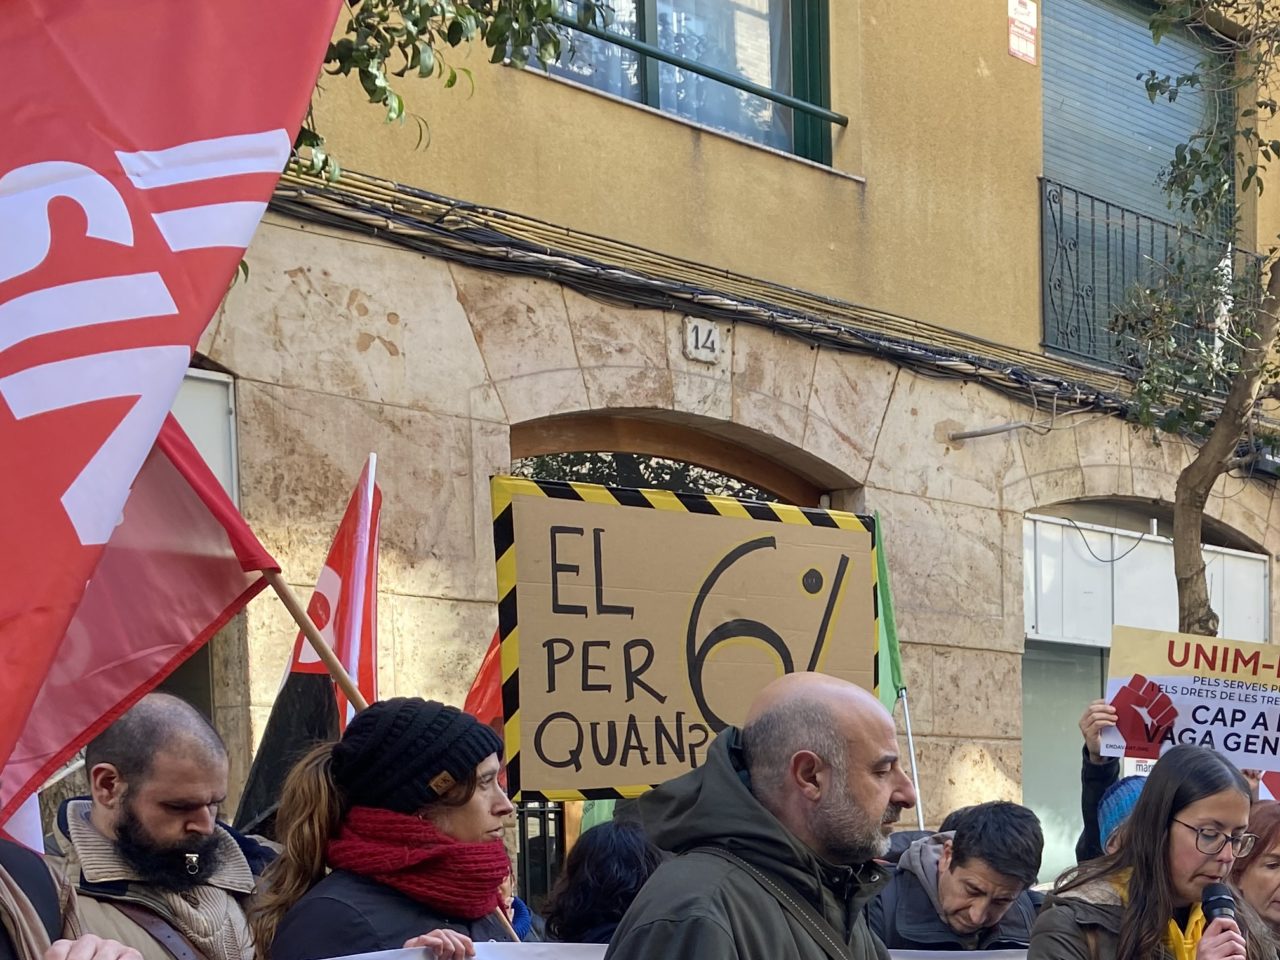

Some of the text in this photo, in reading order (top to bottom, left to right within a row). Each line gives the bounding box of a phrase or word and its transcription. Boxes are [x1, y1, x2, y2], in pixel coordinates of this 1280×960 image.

[691, 324, 716, 353] 14
[549, 526, 635, 620] EL
[542, 638, 668, 703] PER
[1193, 675, 1221, 687] PELS
[1223, 679, 1268, 692] SERVEIS
[1158, 684, 1178, 694] ELS
[1180, 686, 1217, 699] DRETS
[1220, 691, 1236, 701] DE
[1238, 694, 1258, 704] LES
[1192, 705, 1247, 728] CAP
[1251, 711, 1269, 731] A
[534, 710, 710, 772] QUAN?
[1144, 723, 1216, 750] VAGA
